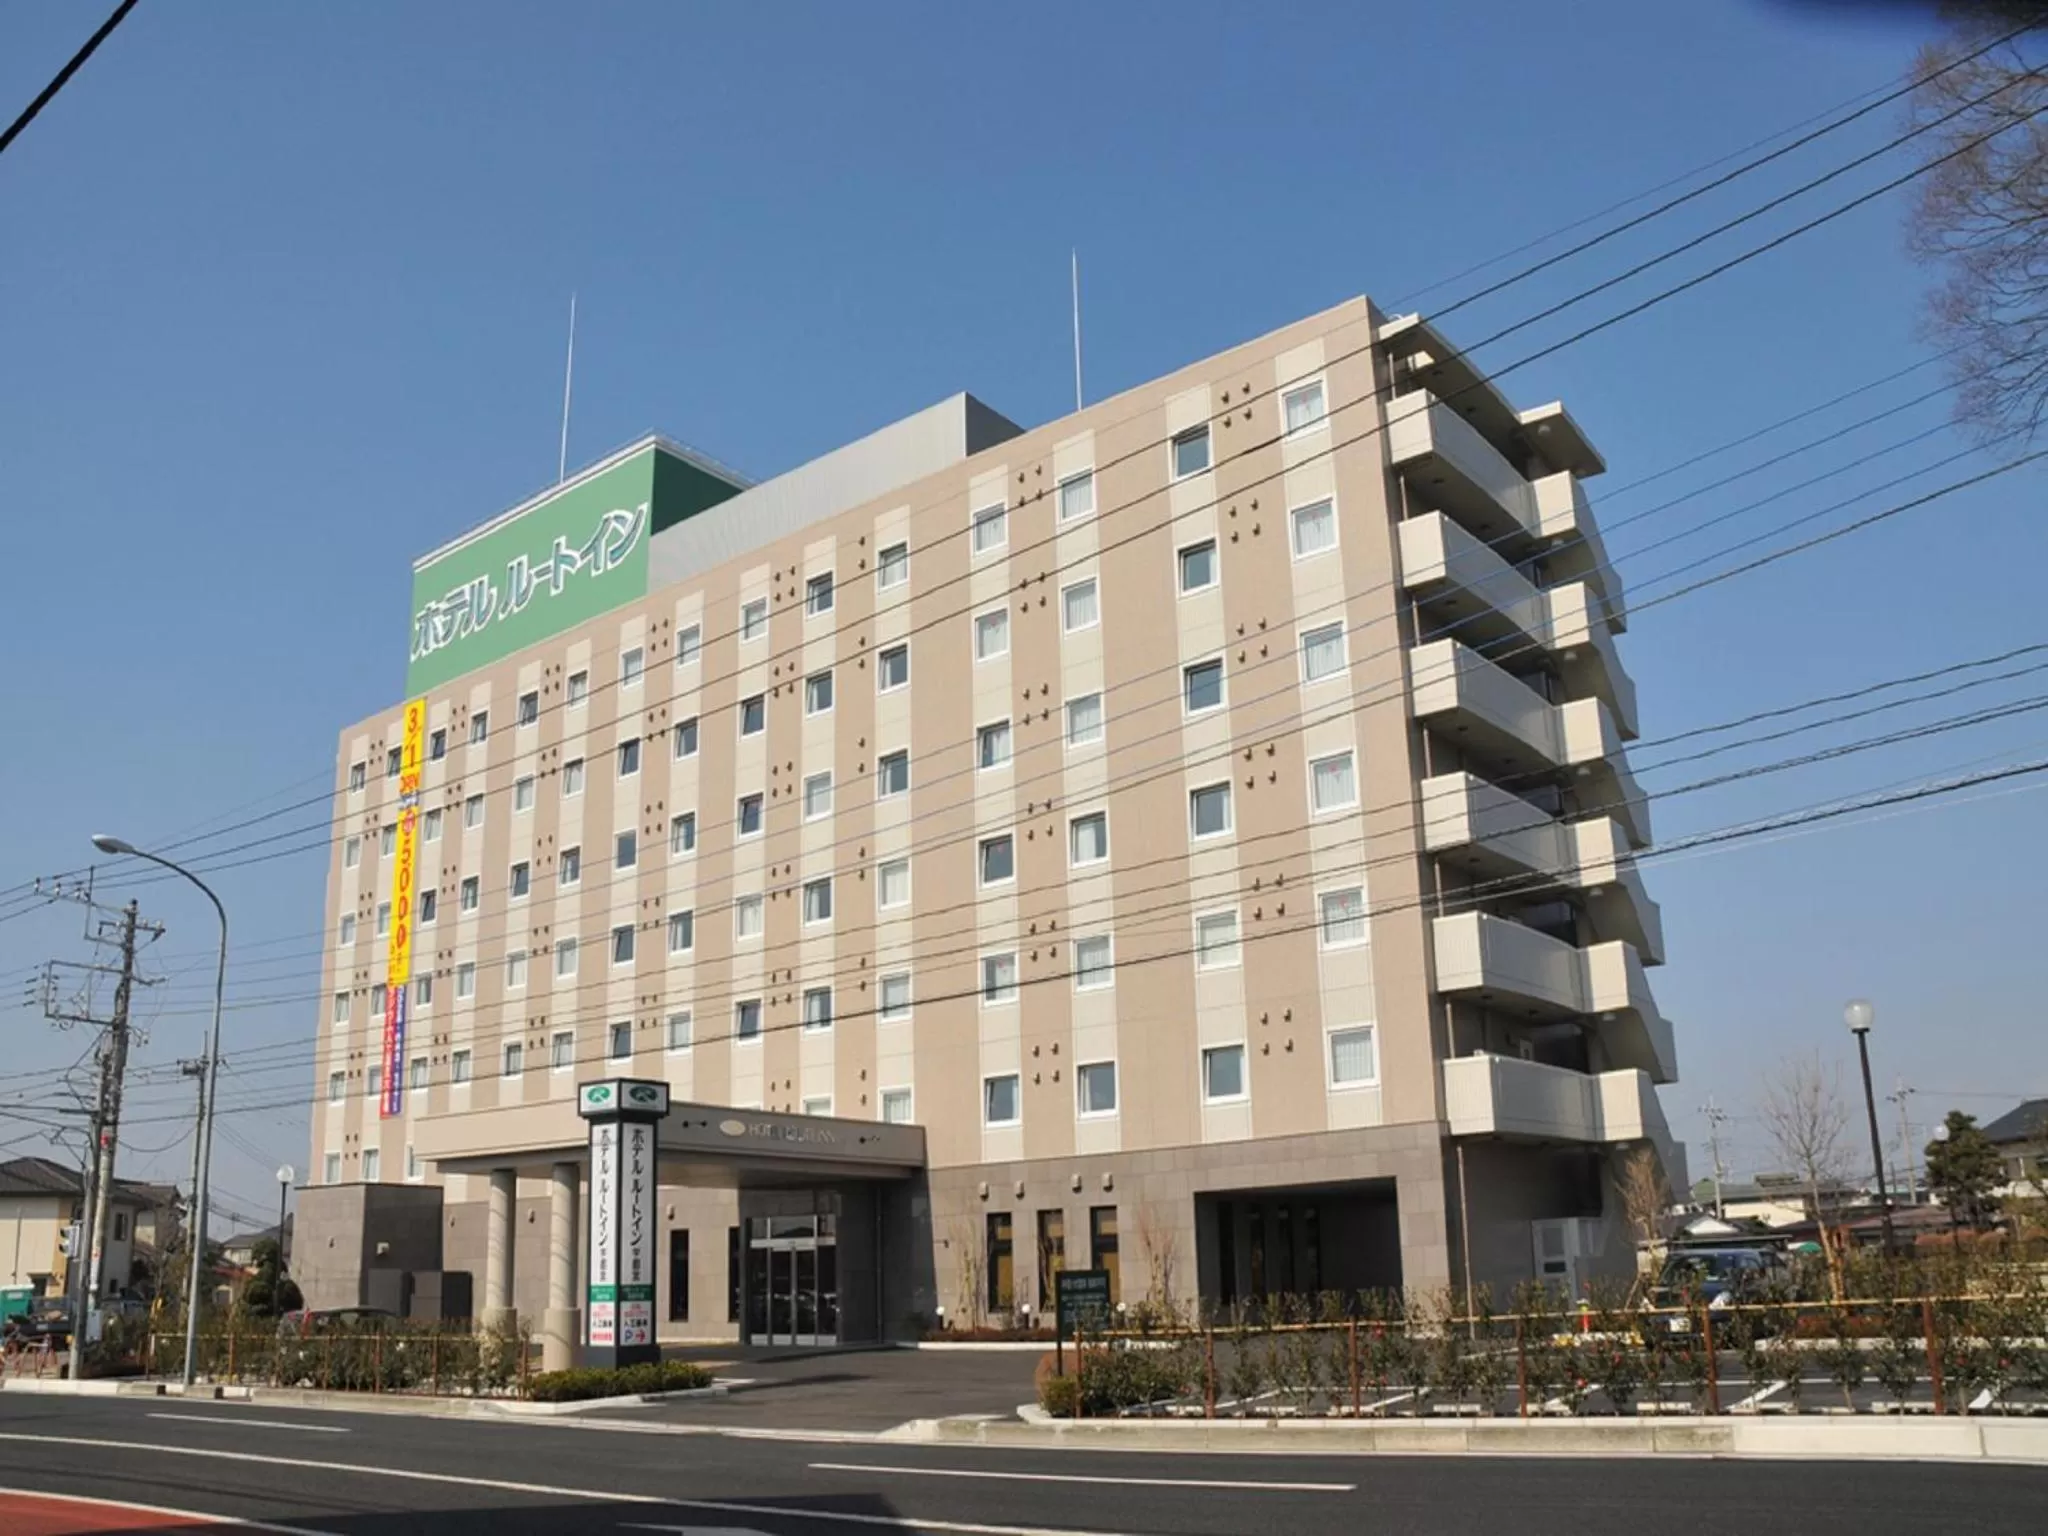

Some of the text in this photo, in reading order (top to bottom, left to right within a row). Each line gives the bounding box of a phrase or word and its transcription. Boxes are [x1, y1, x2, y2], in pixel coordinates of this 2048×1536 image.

[410, 502, 648, 662] ホテル ルートイン
[600, 1128, 611, 1174] ホテル
[631, 1128, 645, 1175] ホテル
